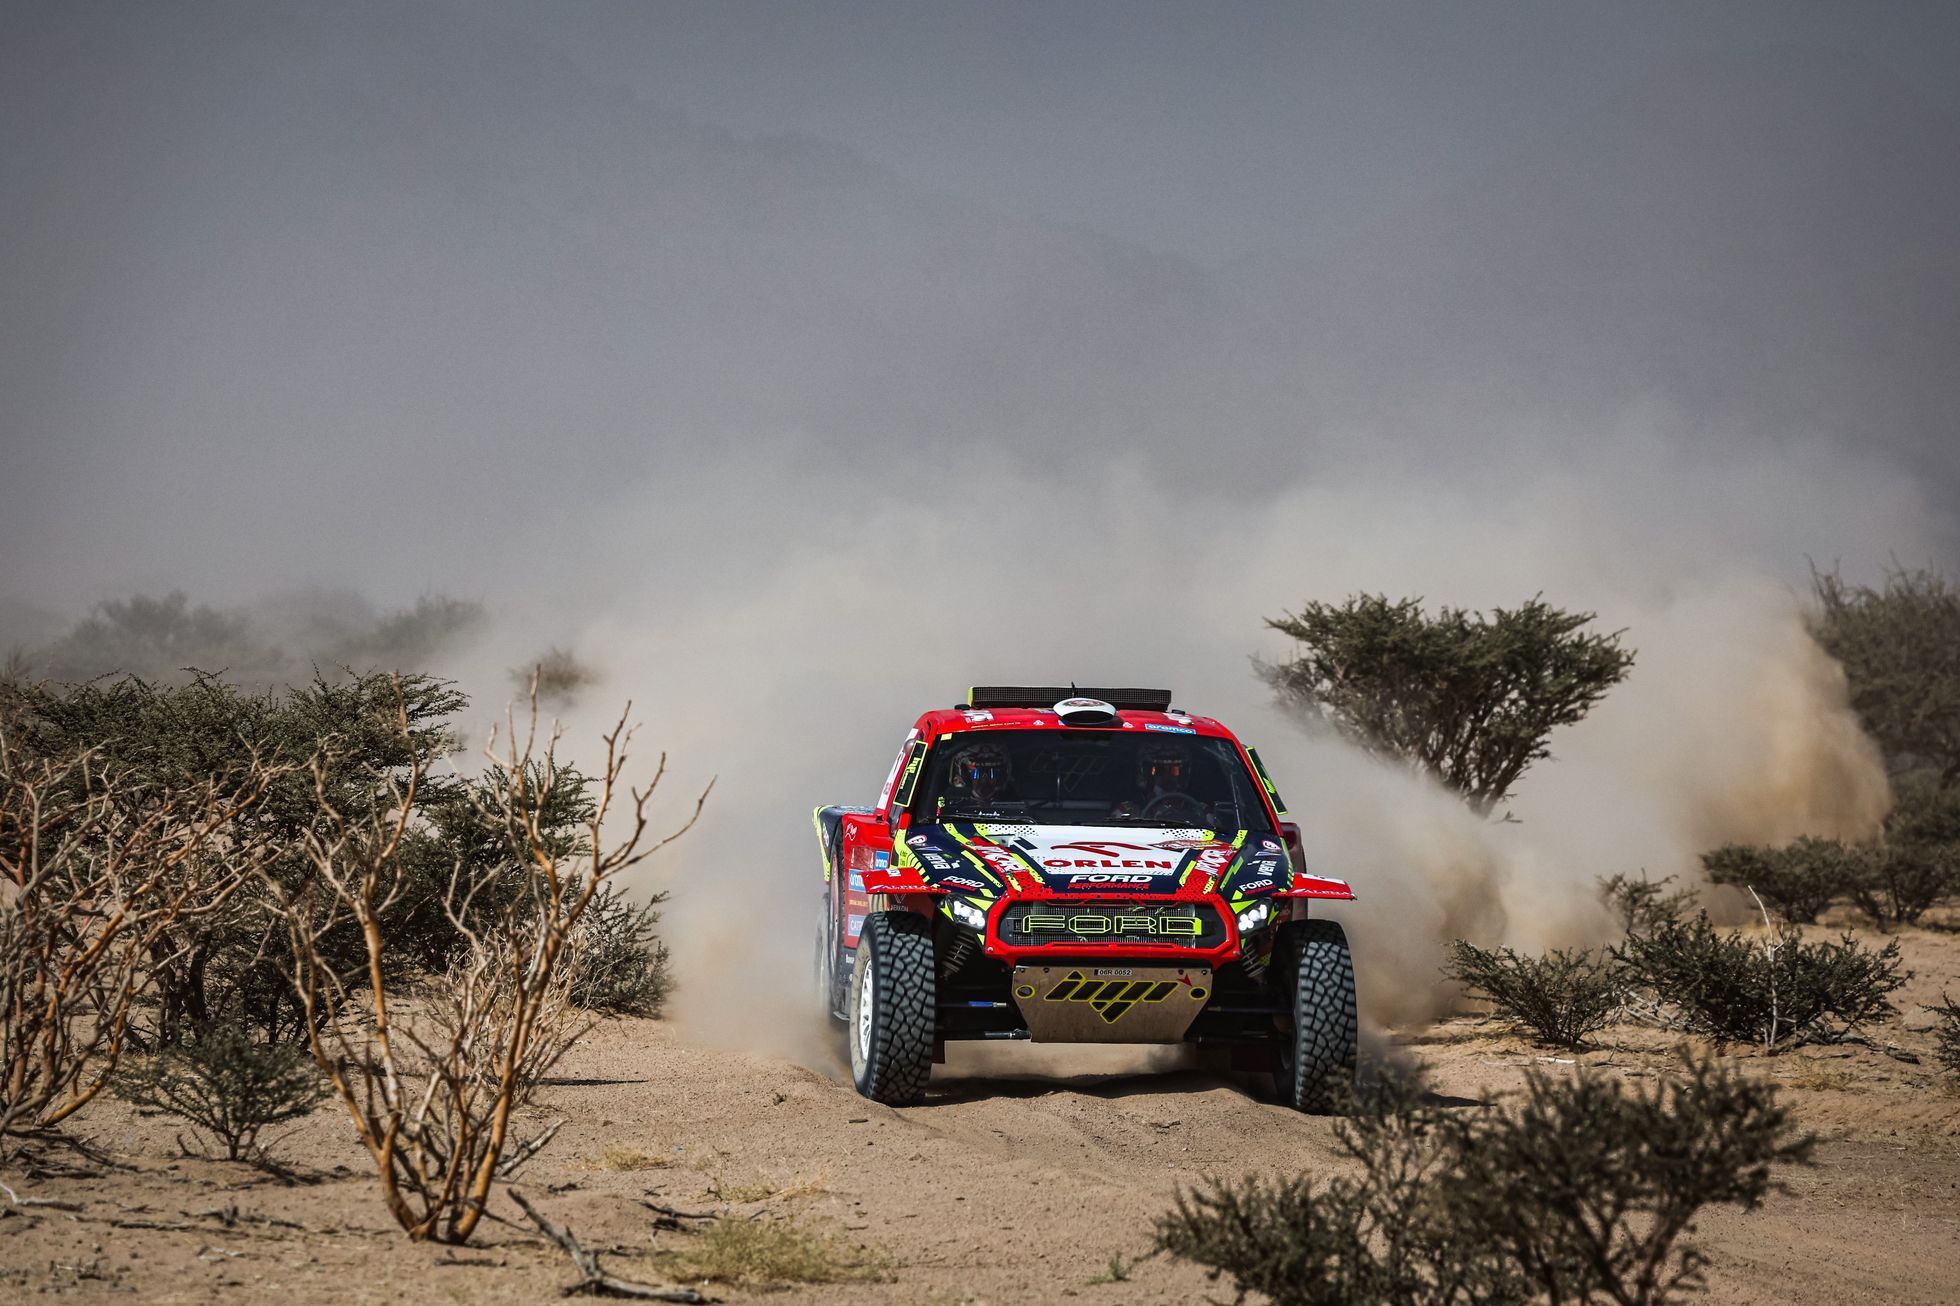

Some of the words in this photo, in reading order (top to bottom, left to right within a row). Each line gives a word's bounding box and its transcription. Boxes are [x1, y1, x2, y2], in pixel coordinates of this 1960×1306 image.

[1148, 724, 1193, 734] aramco
[1043, 859, 1172, 869] ORLEN
[943, 875, 985, 888] FORD
[1069, 874, 1153, 883] FORD
[1239, 879, 1274, 892] FORD
[1022, 914, 1202, 935] FORD
